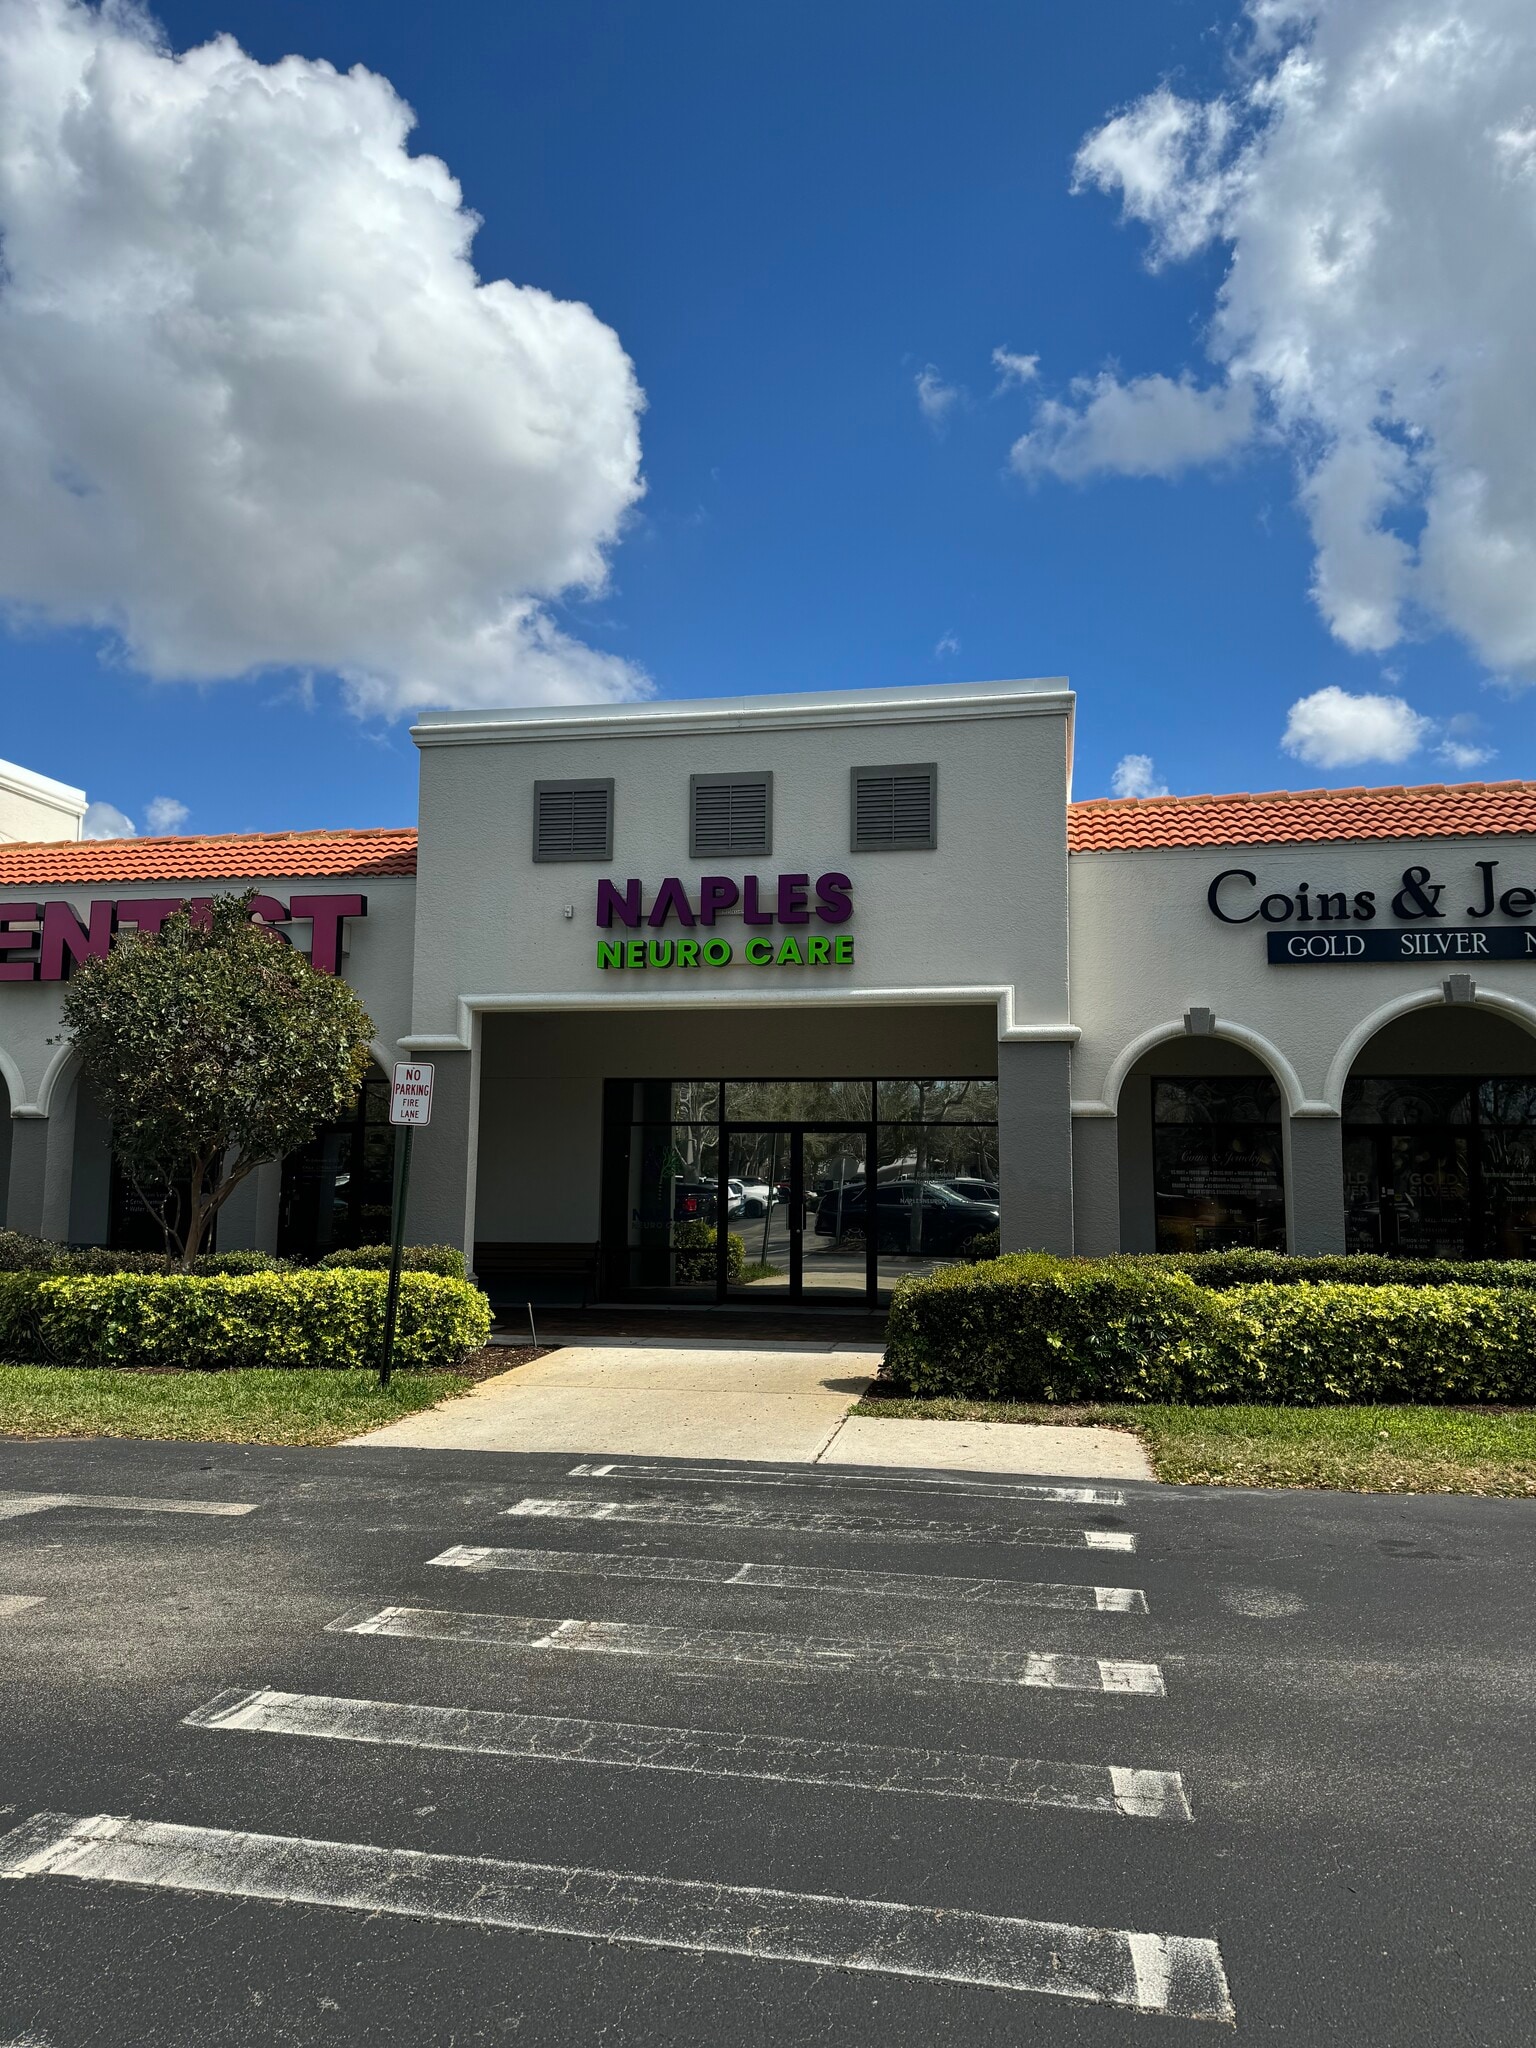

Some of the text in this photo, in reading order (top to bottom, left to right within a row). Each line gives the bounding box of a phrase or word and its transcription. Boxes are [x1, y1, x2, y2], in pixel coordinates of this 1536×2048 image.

[596, 872, 853, 928] NAPLES
[1207, 860, 1536, 924] Coins & Je
[596, 935, 855, 970] NEURO CARE
[1287, 935, 1366, 958] GOLD
[1400, 932, 1490, 956] SILVER
[405, 1069, 421, 1081] NO
[395, 1083, 429, 1096] PARKING
[402, 1098, 420, 1107] FIRE
[400, 1110, 420, 1118] LANE
